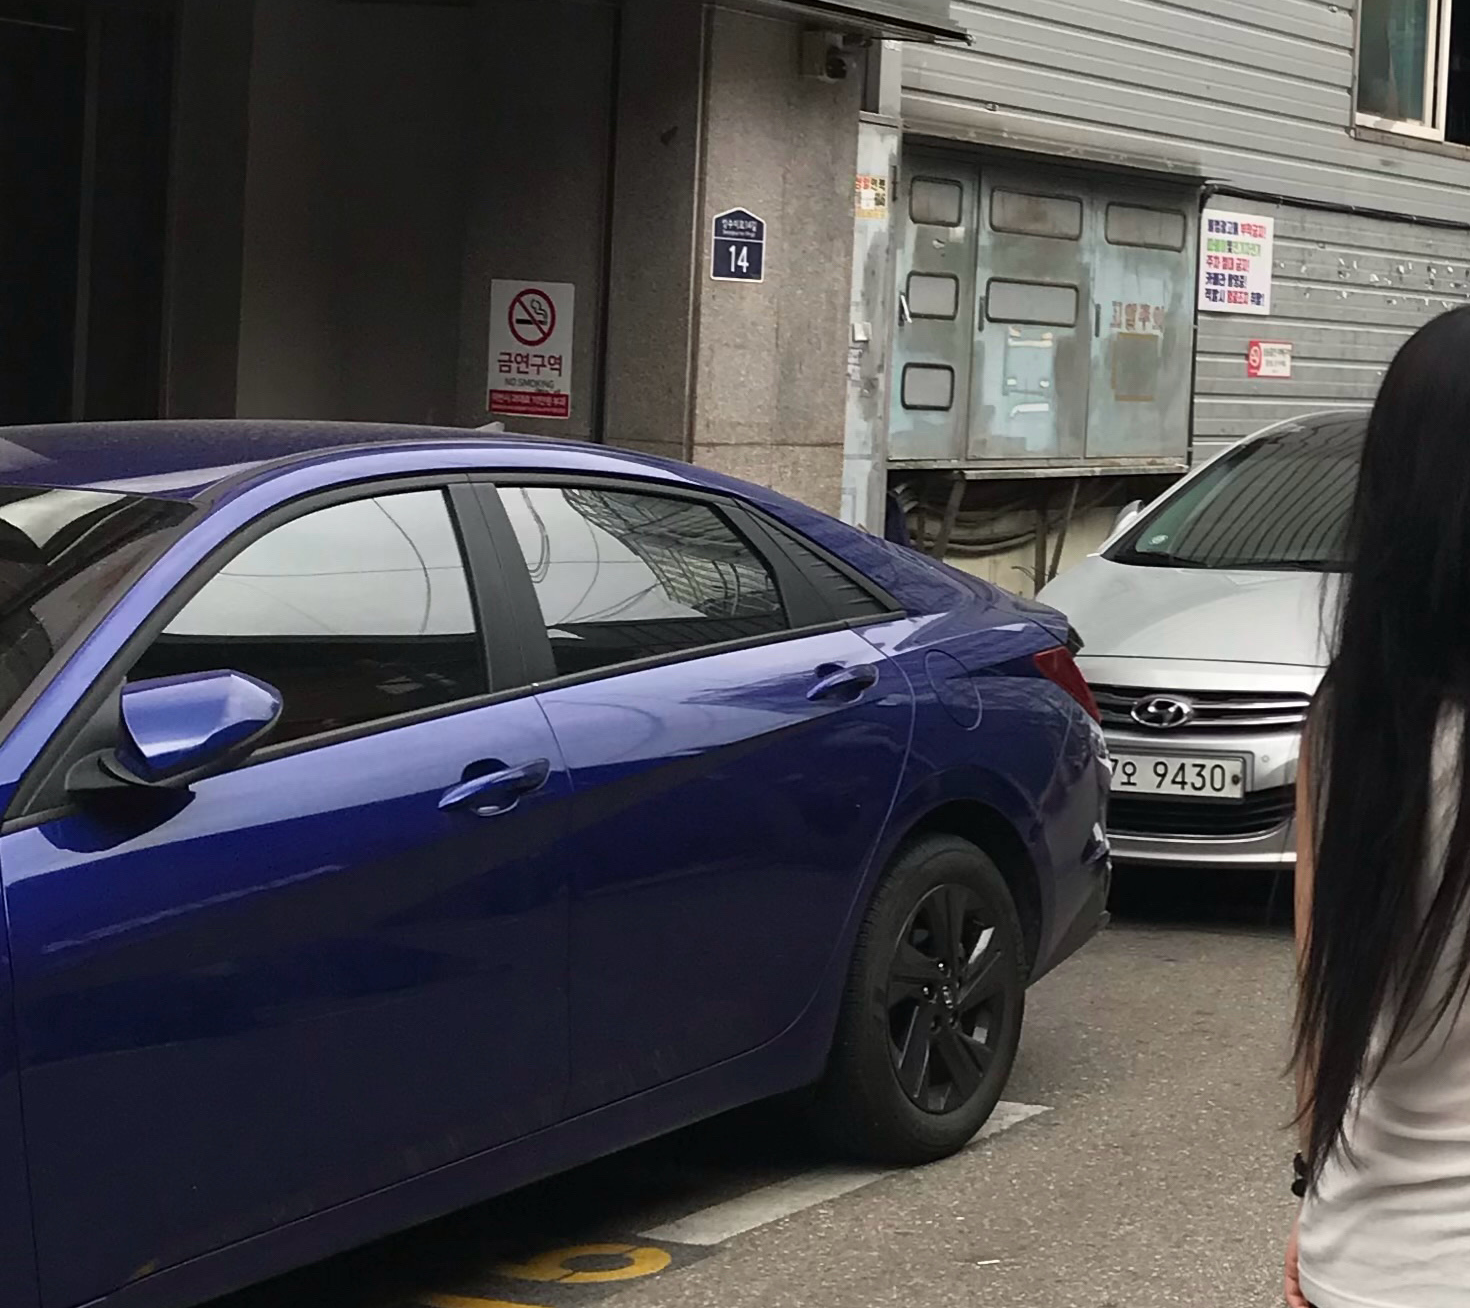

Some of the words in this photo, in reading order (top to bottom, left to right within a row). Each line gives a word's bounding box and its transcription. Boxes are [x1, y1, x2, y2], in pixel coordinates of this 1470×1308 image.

[728, 244, 750, 273] 14
[497, 351, 563, 378] 금연구역
[504, 377, 516, 386] NO
[517, 378, 555, 389] SMOKING
[1152, 760, 1226, 793] 9430
